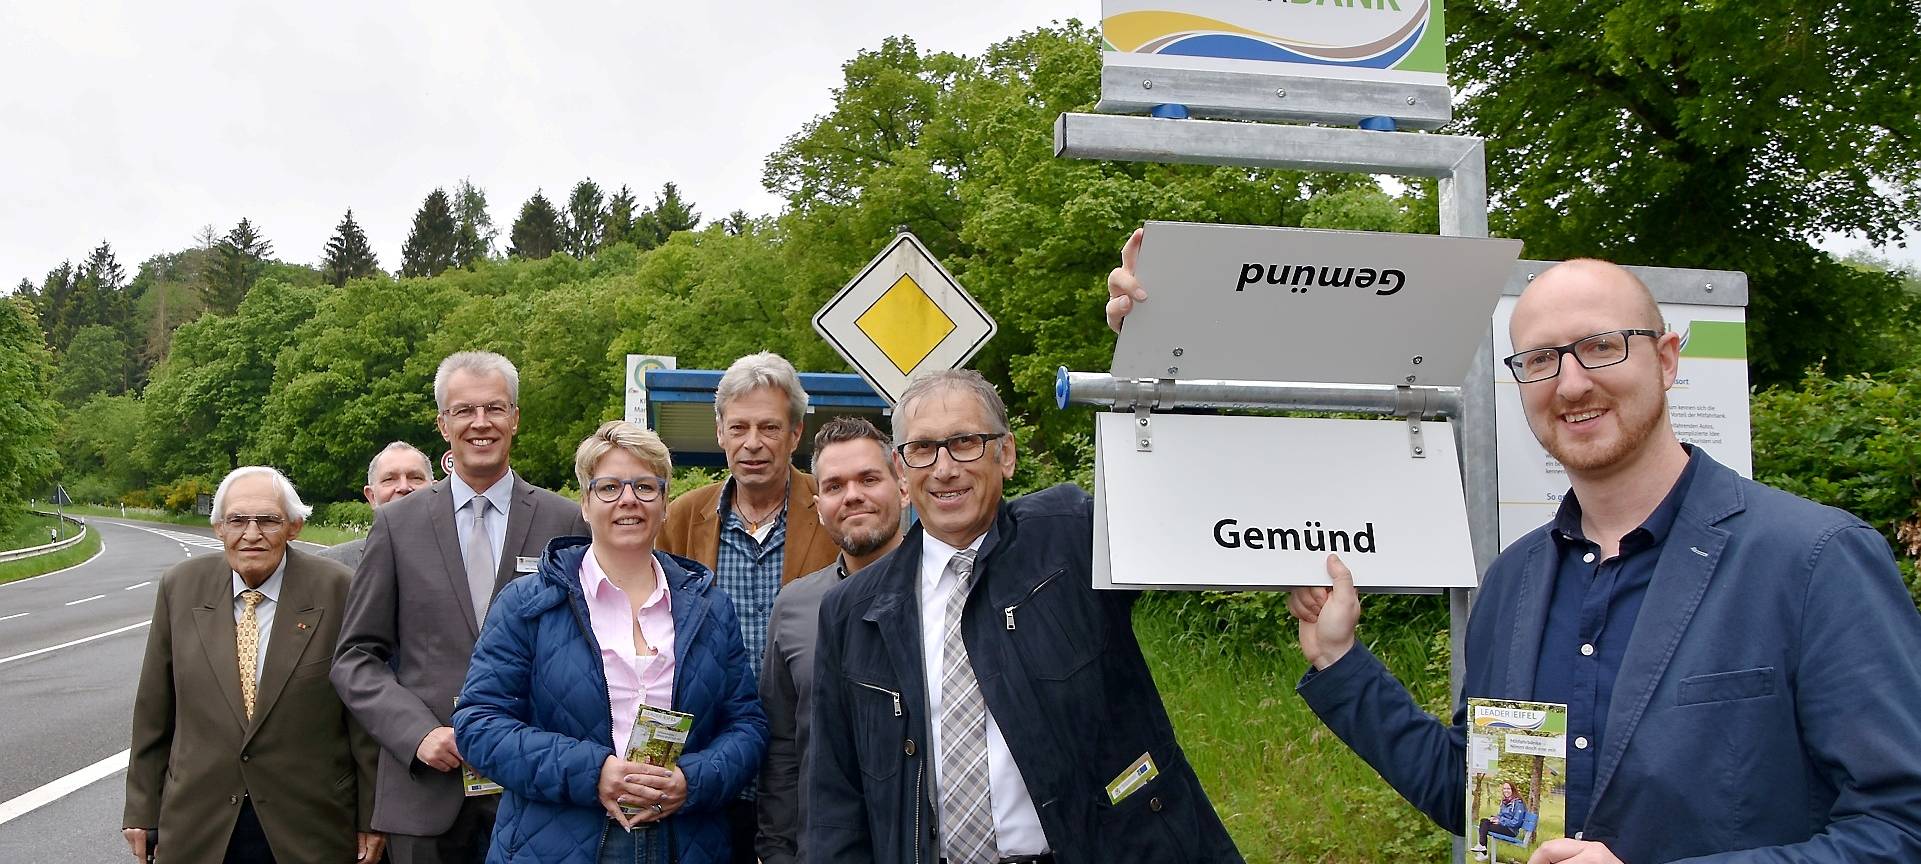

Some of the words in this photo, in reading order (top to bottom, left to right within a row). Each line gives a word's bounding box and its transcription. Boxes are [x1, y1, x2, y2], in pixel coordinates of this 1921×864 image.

[1235, 263, 1406, 296] Gemünd
[447, 457, 454, 468] 5
[1546, 492, 1556, 501] So
[1213, 518, 1377, 554] Gemünd
[1480, 708, 1510, 718] LEADER
[1513, 710, 1537, 720] EIFEL
